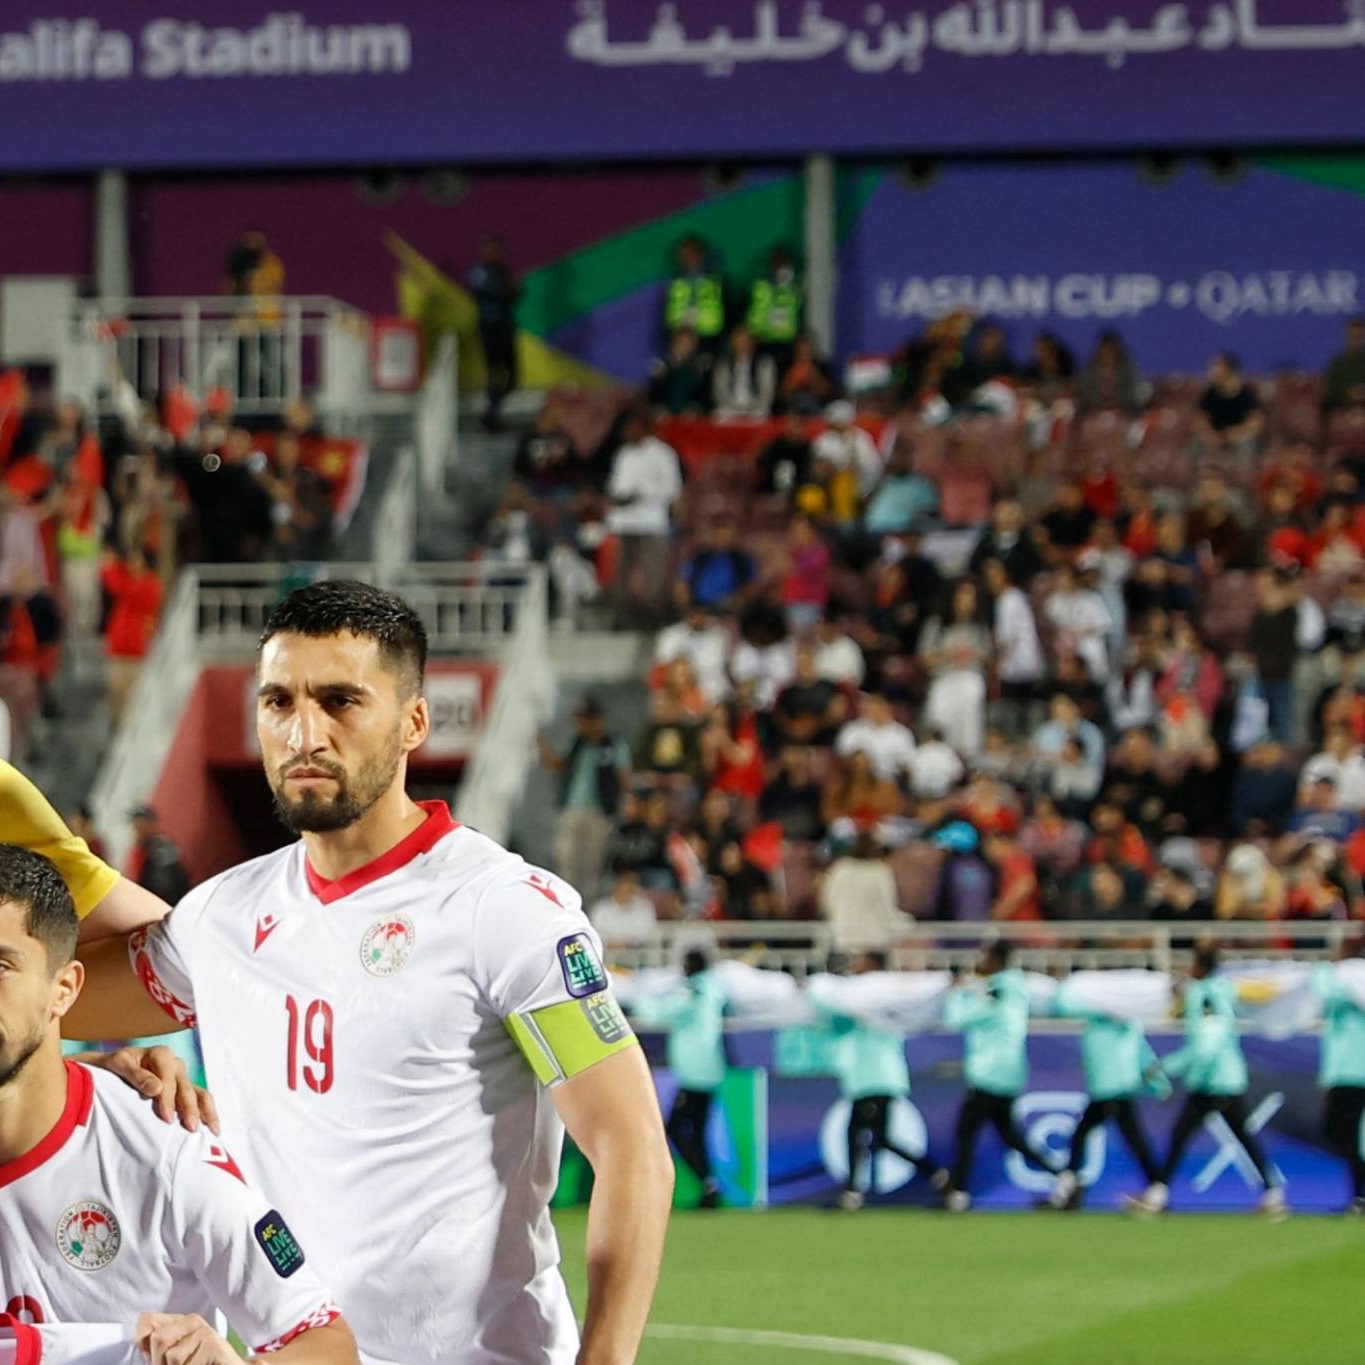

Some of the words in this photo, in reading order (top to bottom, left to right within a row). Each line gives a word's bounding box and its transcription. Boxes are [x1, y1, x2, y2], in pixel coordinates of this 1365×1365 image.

[140, 12, 412, 78] Stadium
[898, 273, 1050, 319] ASIAN
[1054, 273, 1161, 319] CUP
[1195, 269, 1359, 326] QATAR
[564, 942, 583, 956] AFC
[285, 994, 334, 1095] 19
[262, 1224, 277, 1242] AFC
[267, 1228, 291, 1257] LIVE
